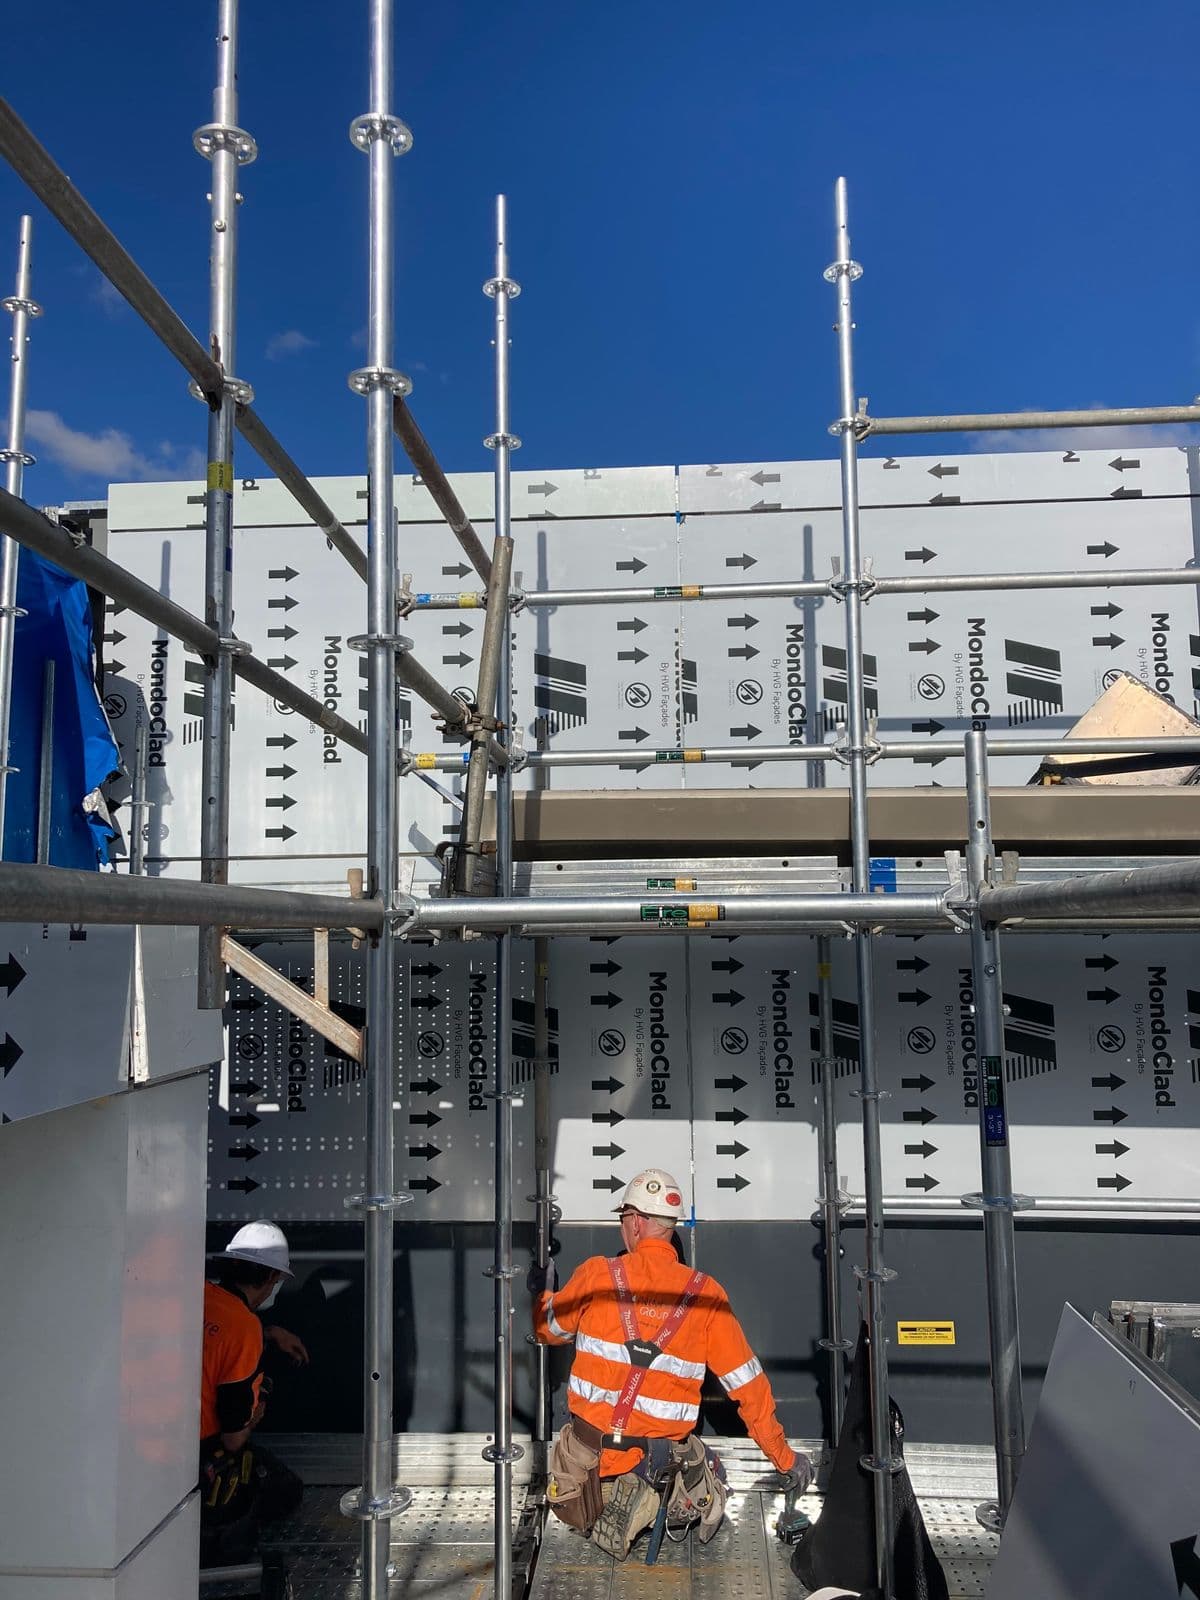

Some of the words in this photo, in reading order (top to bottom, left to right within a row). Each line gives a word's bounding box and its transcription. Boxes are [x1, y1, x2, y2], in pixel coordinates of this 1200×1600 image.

[952, 653, 963, 664] By
[1136, 648, 1147, 659] By
[1151, 613, 1176, 705] Mondo
[659, 662, 669, 673] By
[771, 658, 781, 670] By
[1140, 661, 1149, 679] HVG
[308, 669, 318, 682] By
[661, 675, 670, 692] HVG
[773, 671, 782, 689] HVG
[955, 666, 964, 684] HVG
[968, 618, 991, 732] MondoCla
[149, 640, 169, 767] MondoClad
[323, 636, 342, 763] Mondoad
[642, 904, 688, 918] Eiro
[454, 1009, 463, 1021] By
[634, 1007, 645, 1019] By
[755, 1005, 766, 1017] By
[944, 1005, 953, 1016] By
[1133, 1003, 1143, 1014] By
[455, 1023, 463, 1041] HVG
[636, 1021, 645, 1040] HVG
[759, 1019, 768, 1038] HVG
[945, 1018, 955, 1036] HVG
[1136, 1017, 1145, 1035] HVG
[469, 974, 487, 1110] MondoClad
[648, 972, 671, 1110] MondoClad
[771, 969, 795, 1108] MondoClad
[1147, 966, 1176, 1107] MondoClad
[639, 1306, 670, 1319] GROUP
